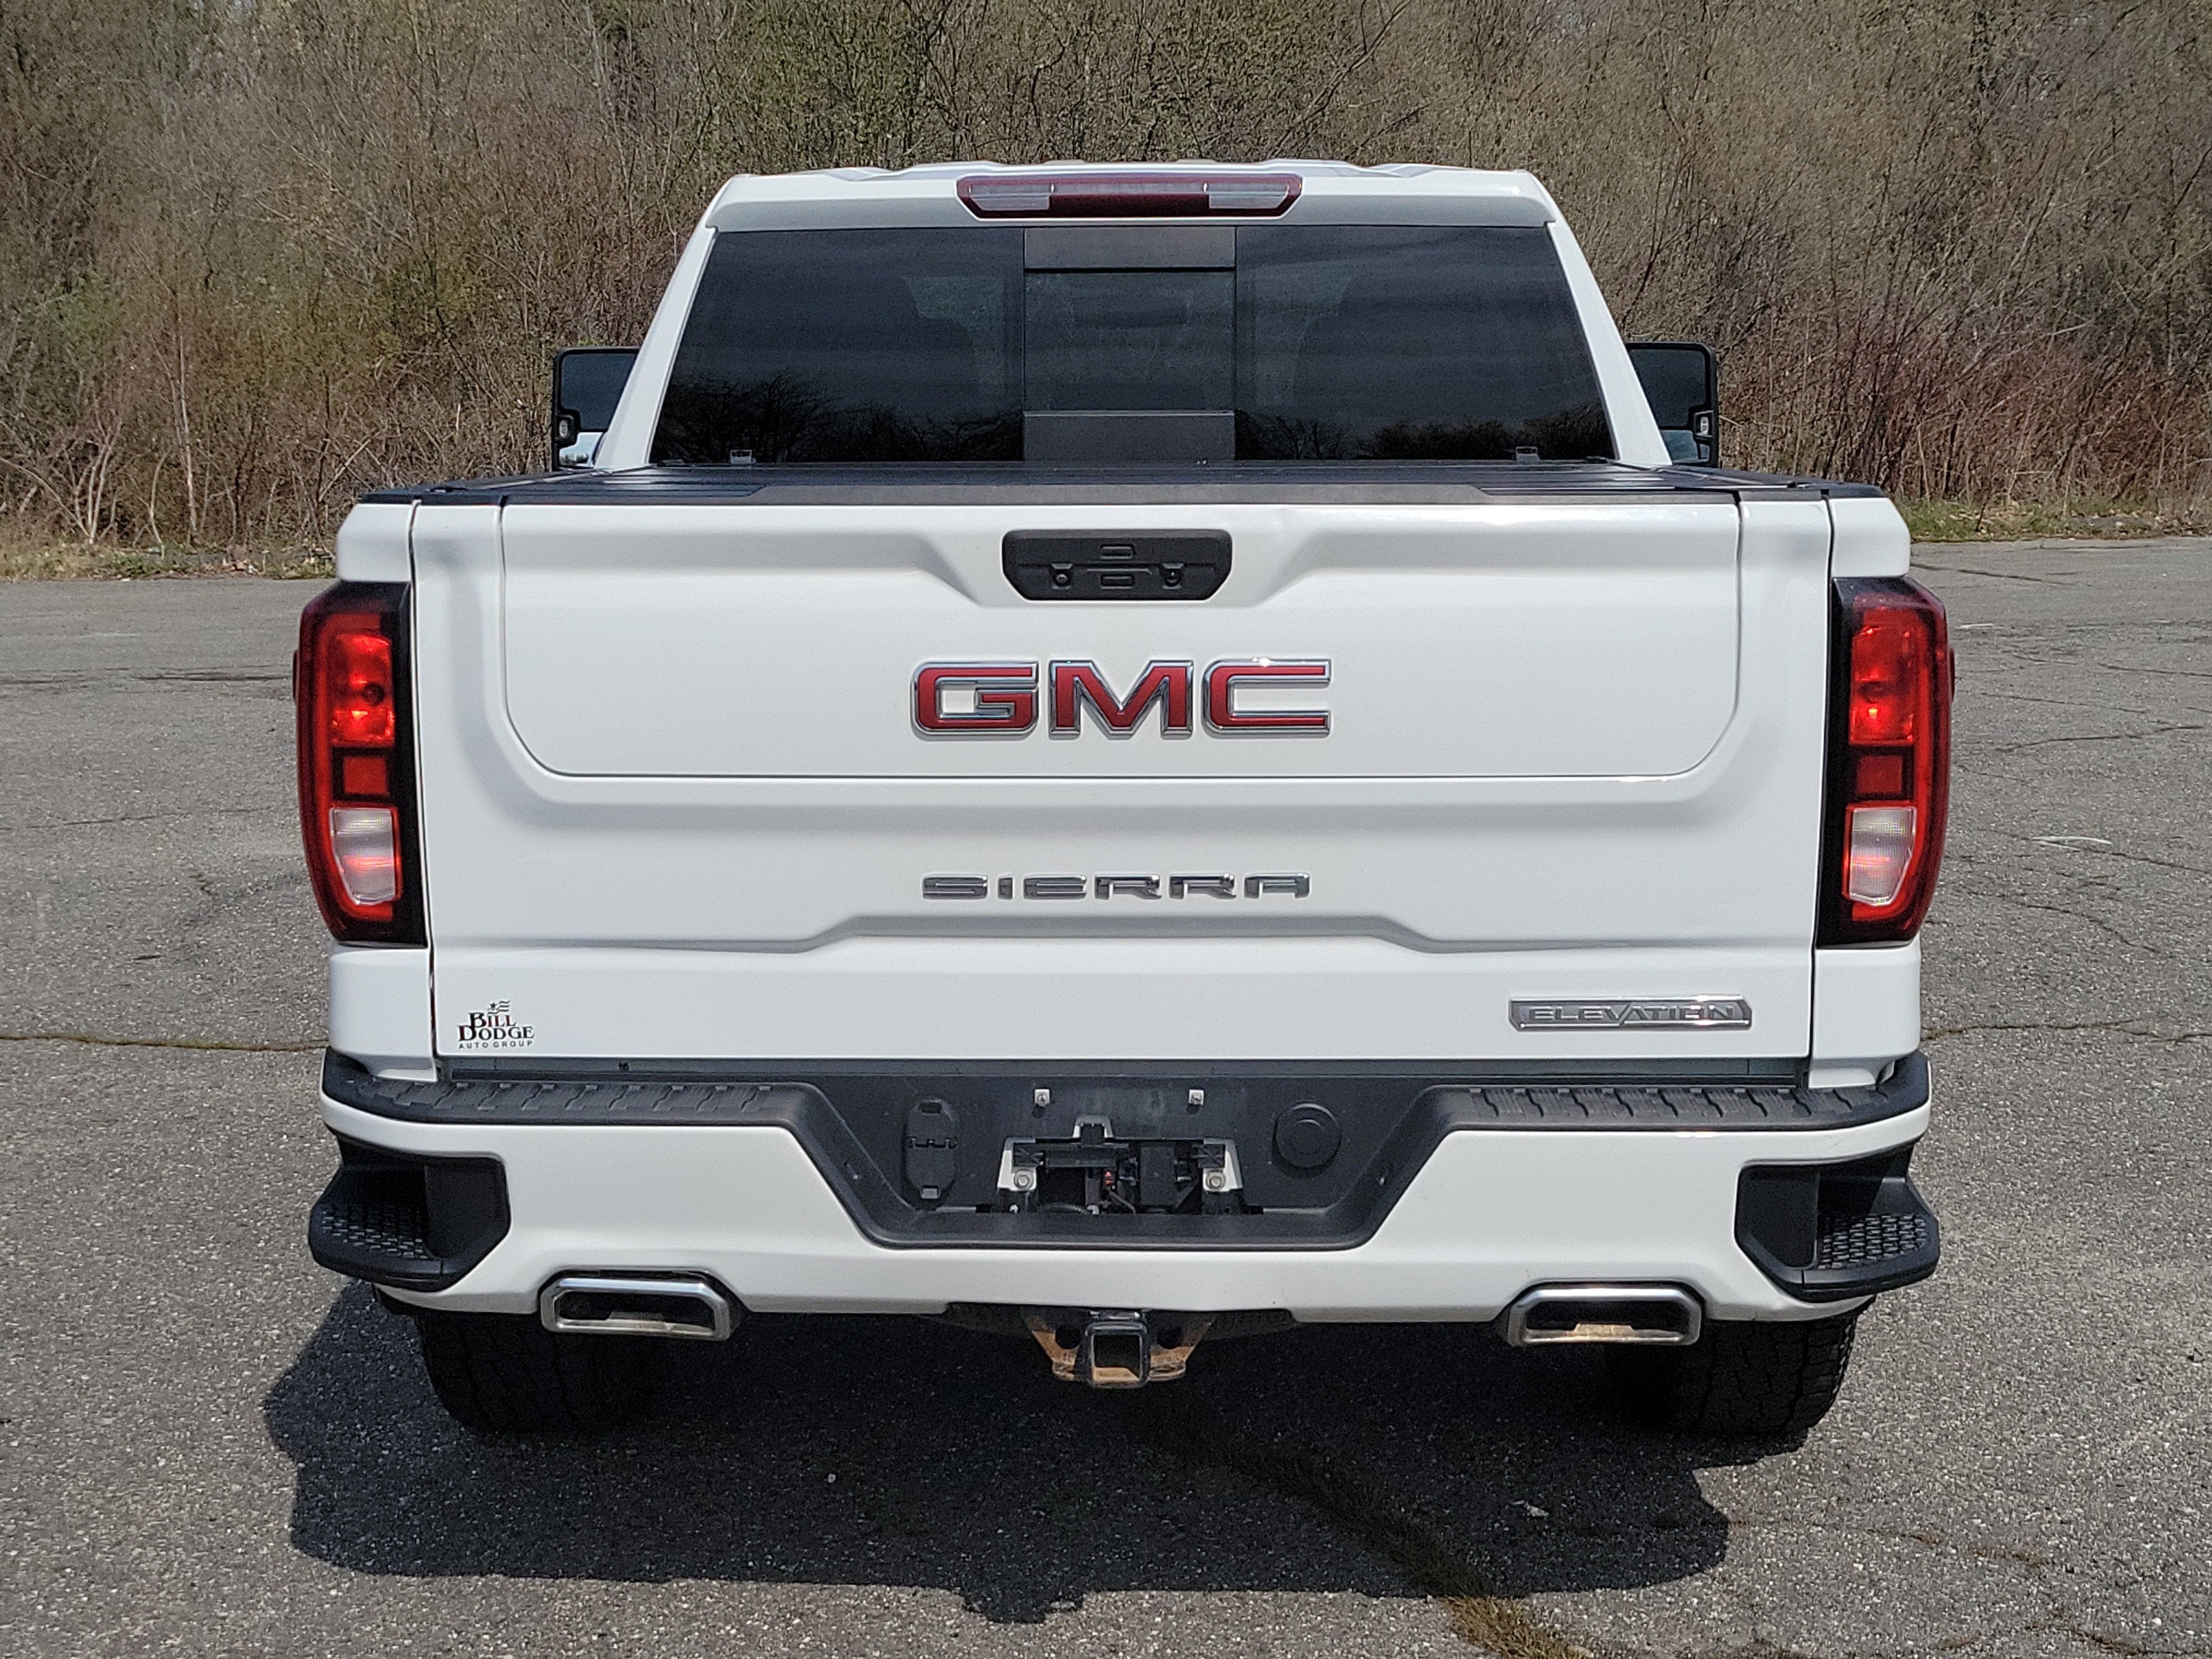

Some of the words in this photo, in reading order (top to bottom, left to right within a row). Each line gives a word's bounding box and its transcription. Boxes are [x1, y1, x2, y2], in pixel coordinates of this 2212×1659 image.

[912, 658, 1330, 740] GMC
[923, 874, 1310, 899] SIERRA
[468, 1012, 517, 1028] BILL
[1528, 1005, 1736, 1022] ELEVATION
[458, 1025, 535, 1041] DODGE
